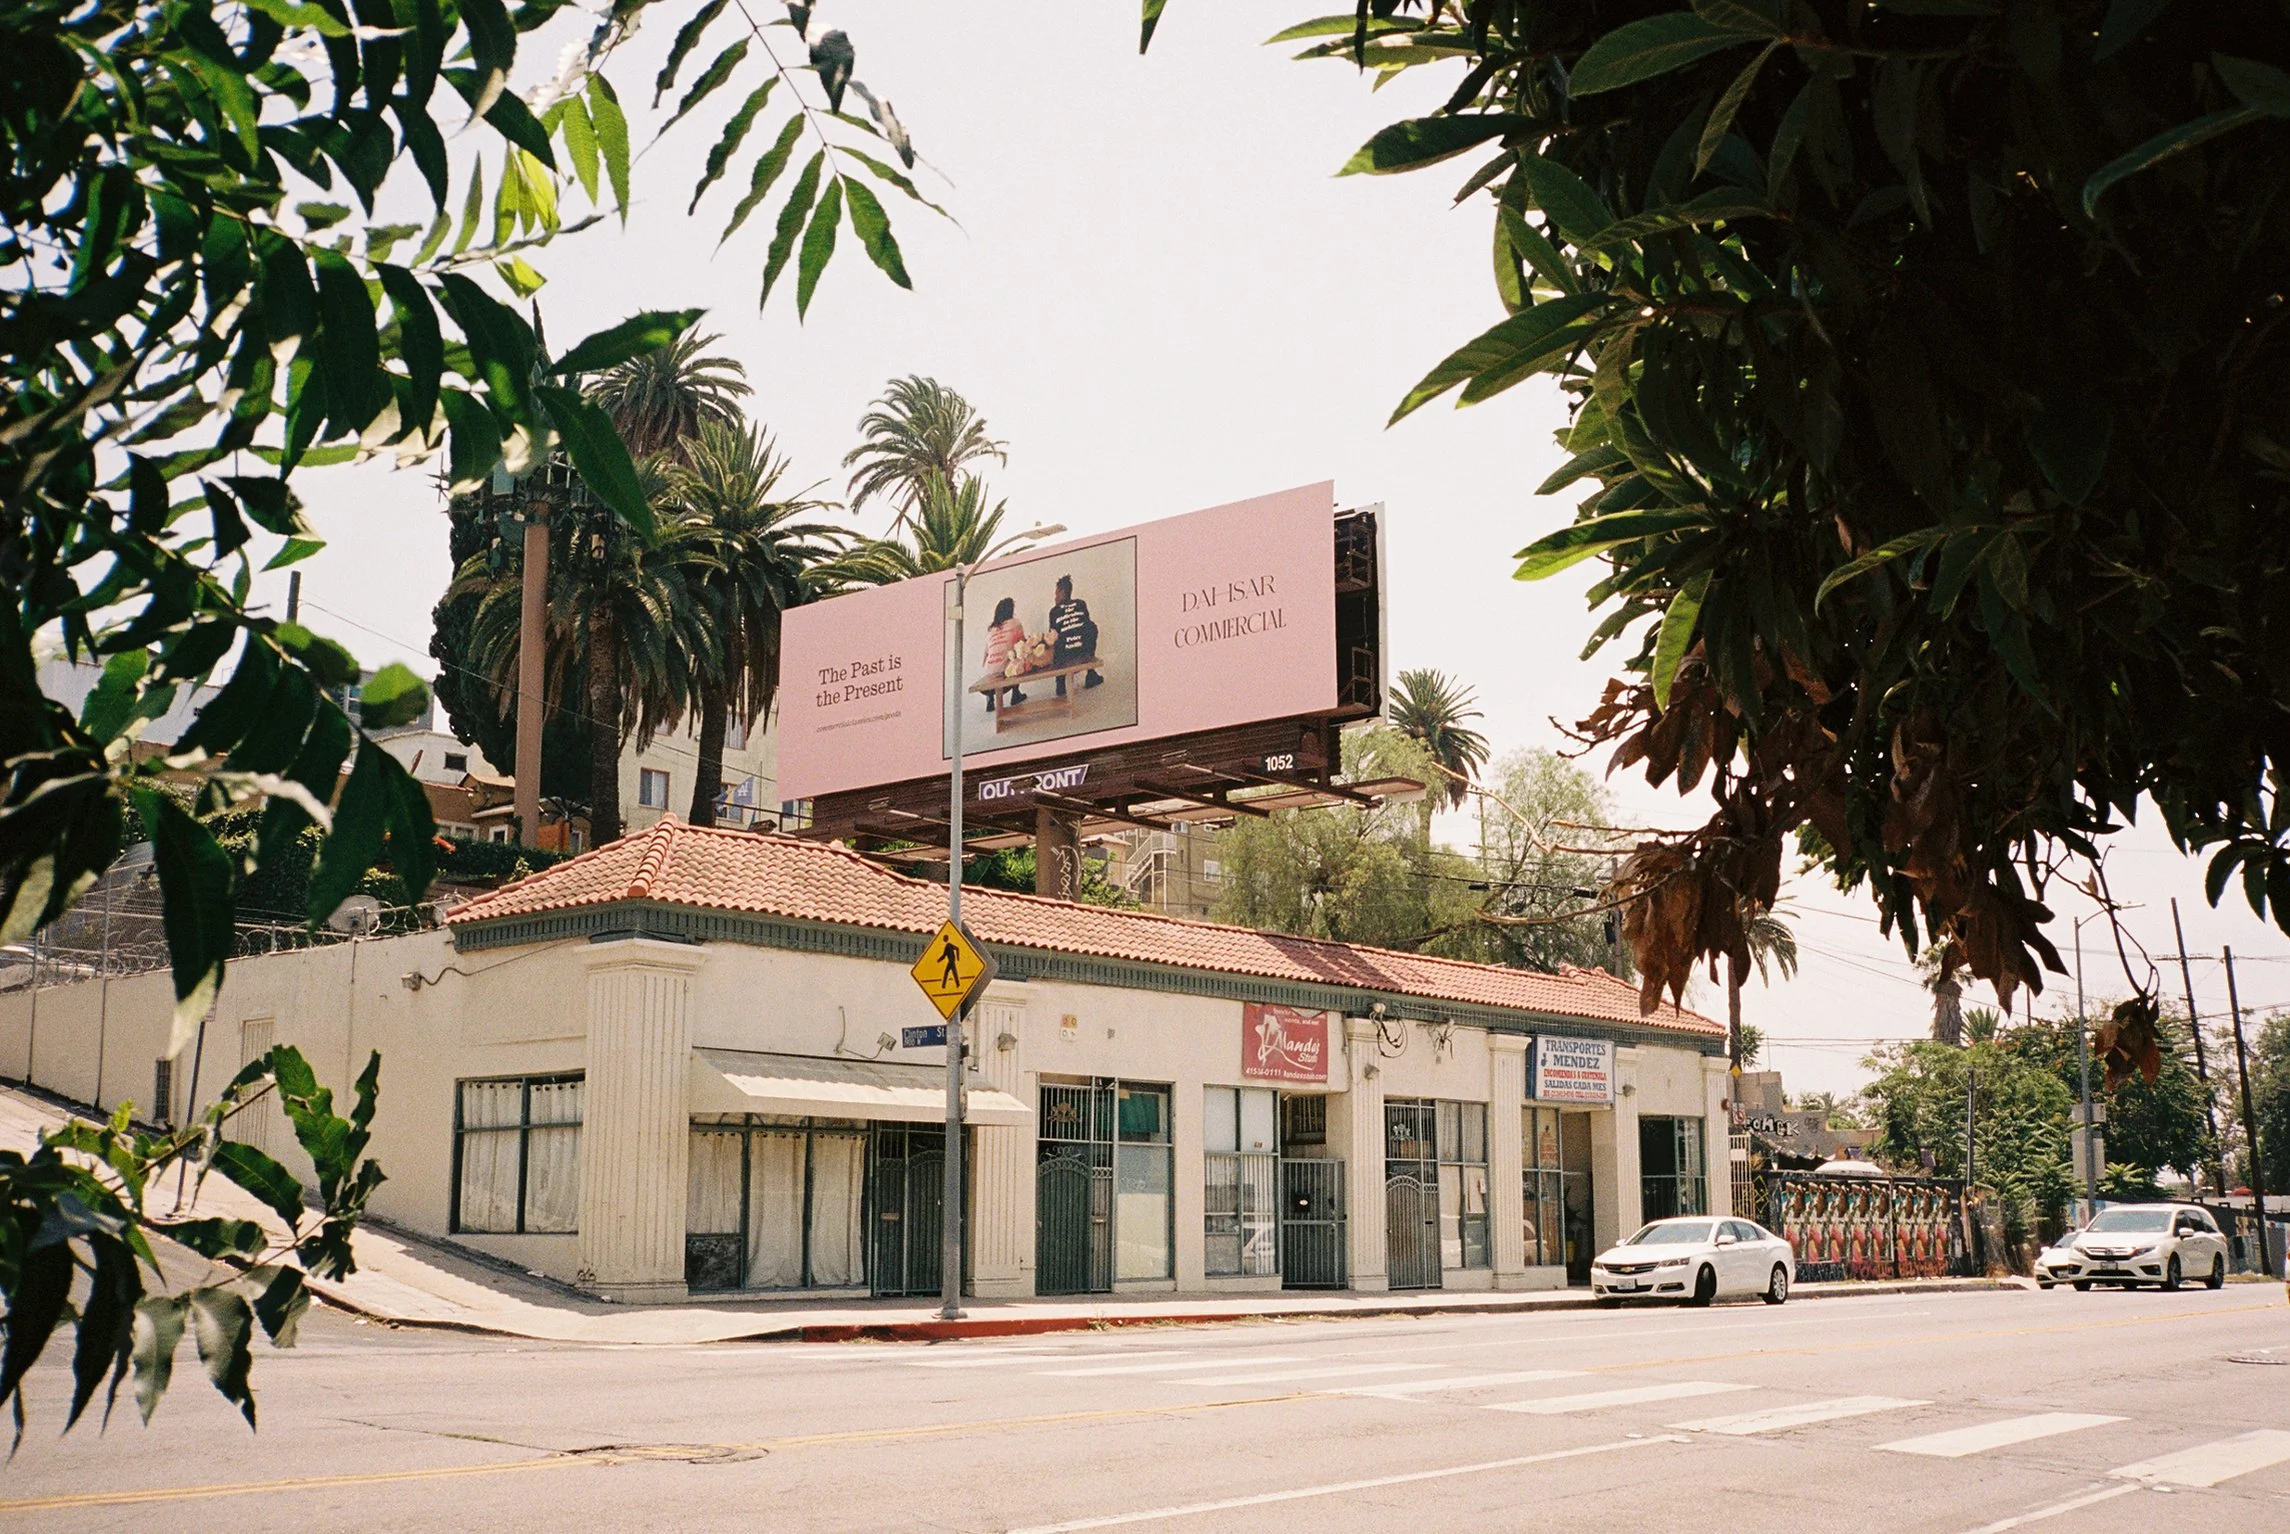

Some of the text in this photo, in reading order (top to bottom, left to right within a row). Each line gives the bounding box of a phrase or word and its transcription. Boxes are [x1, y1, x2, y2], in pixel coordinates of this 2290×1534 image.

[1174, 608, 1287, 648] COMMERCIAL
[818, 654, 902, 685] The Past is
[816, 675, 904, 708] the Present
[1265, 754, 1293, 771] 1052
[936, 1026, 945, 1037] St
[1545, 1039, 1606, 1056] TRANSPORTES
[1553, 1054, 1600, 1069] MENDEZ
[1544, 1079, 1606, 1091] SALIDAS CADA MES
